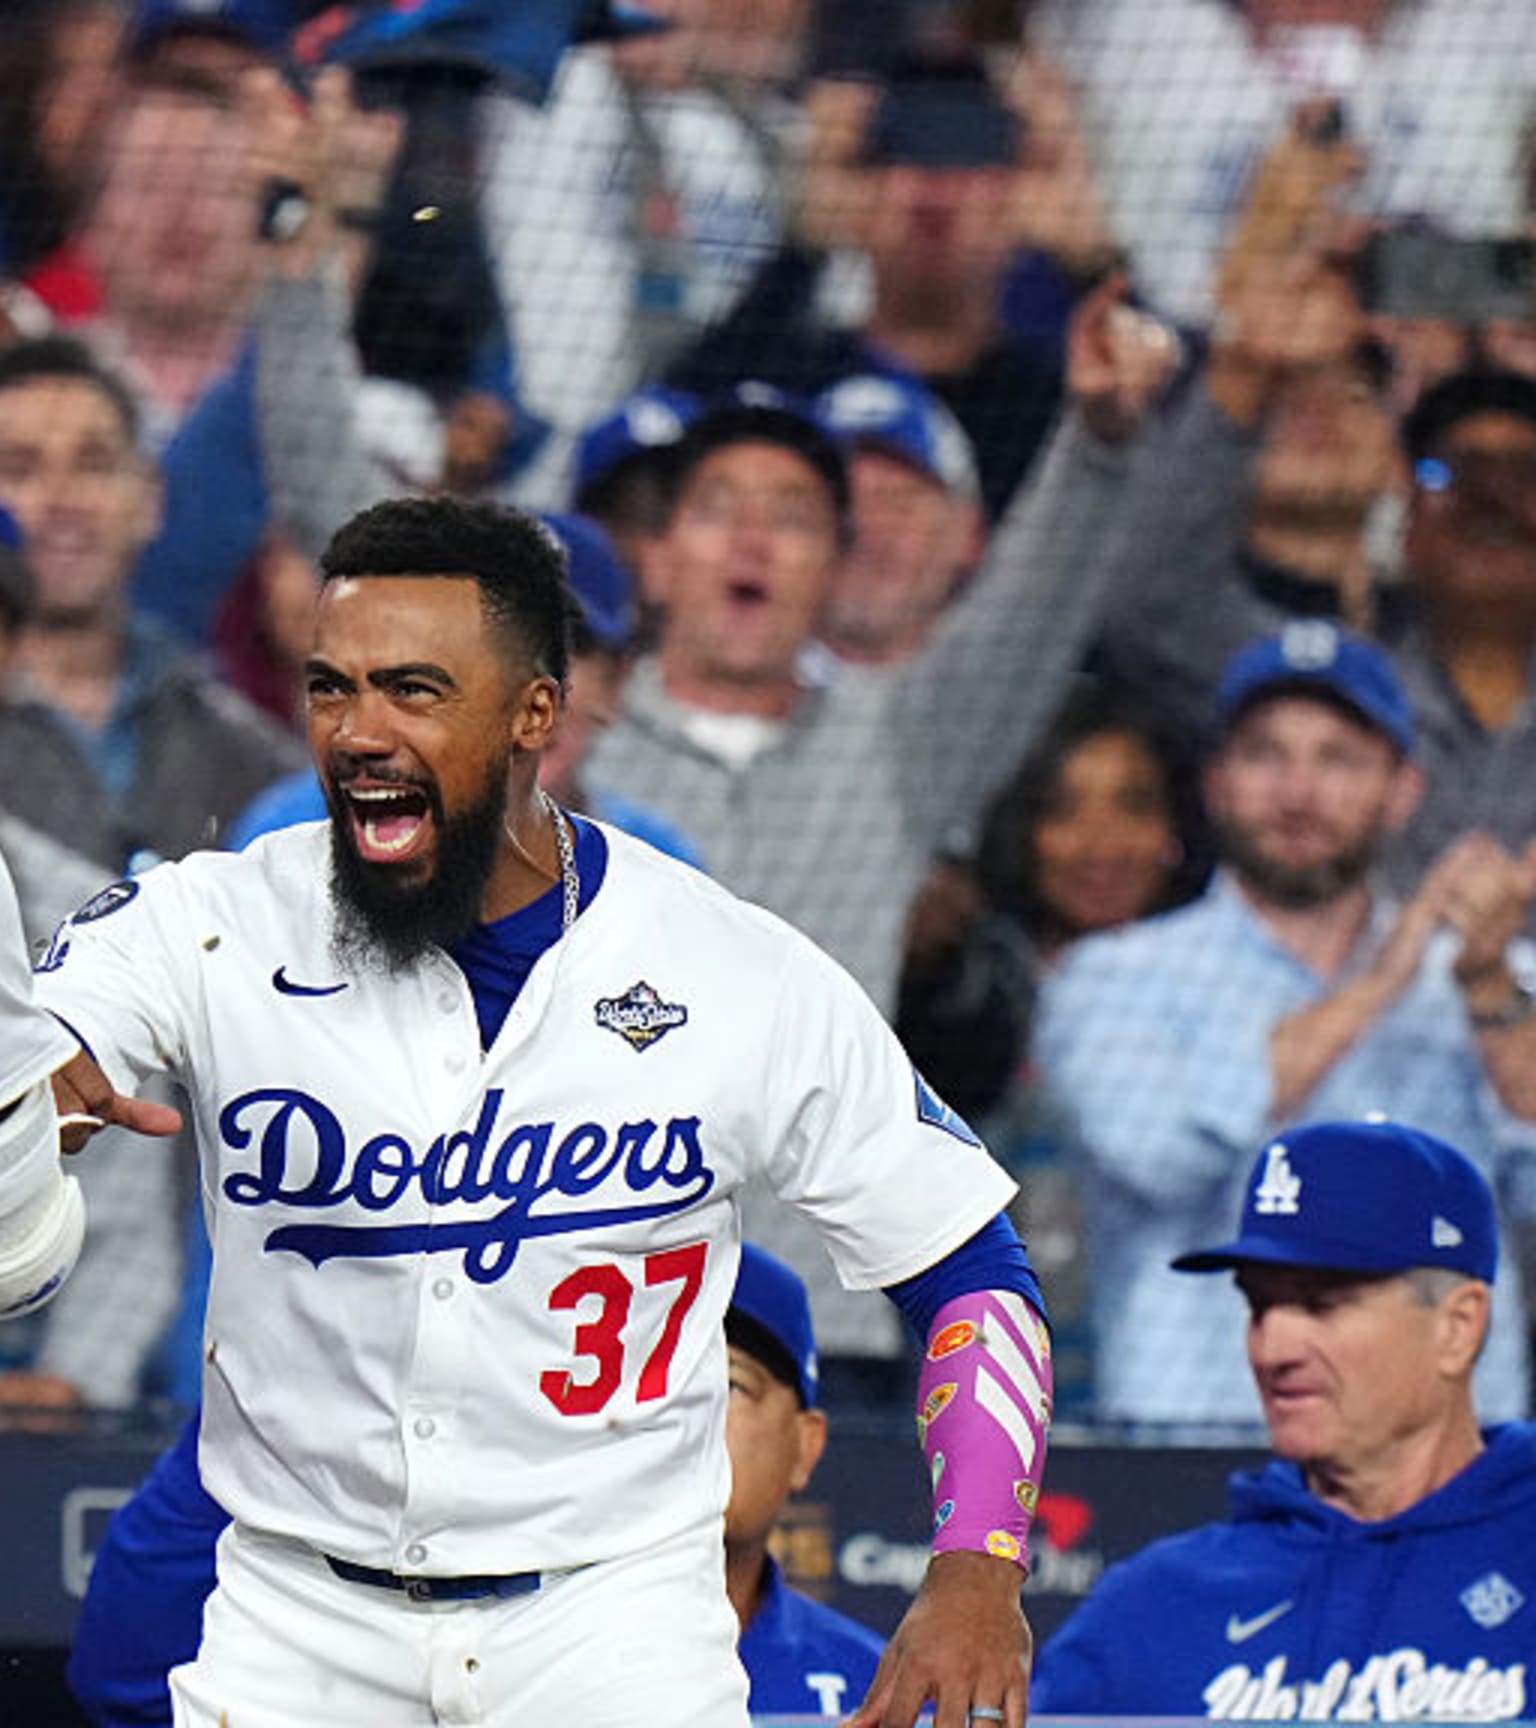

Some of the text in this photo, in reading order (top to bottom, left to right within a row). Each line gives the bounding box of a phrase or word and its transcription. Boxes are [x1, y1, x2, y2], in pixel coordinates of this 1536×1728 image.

[219, 1088, 715, 1285] Dodgers
[1255, 1142, 1302, 1215] LA
[539, 1241, 709, 1417] 37
[1202, 1647, 1526, 1722] World Series
